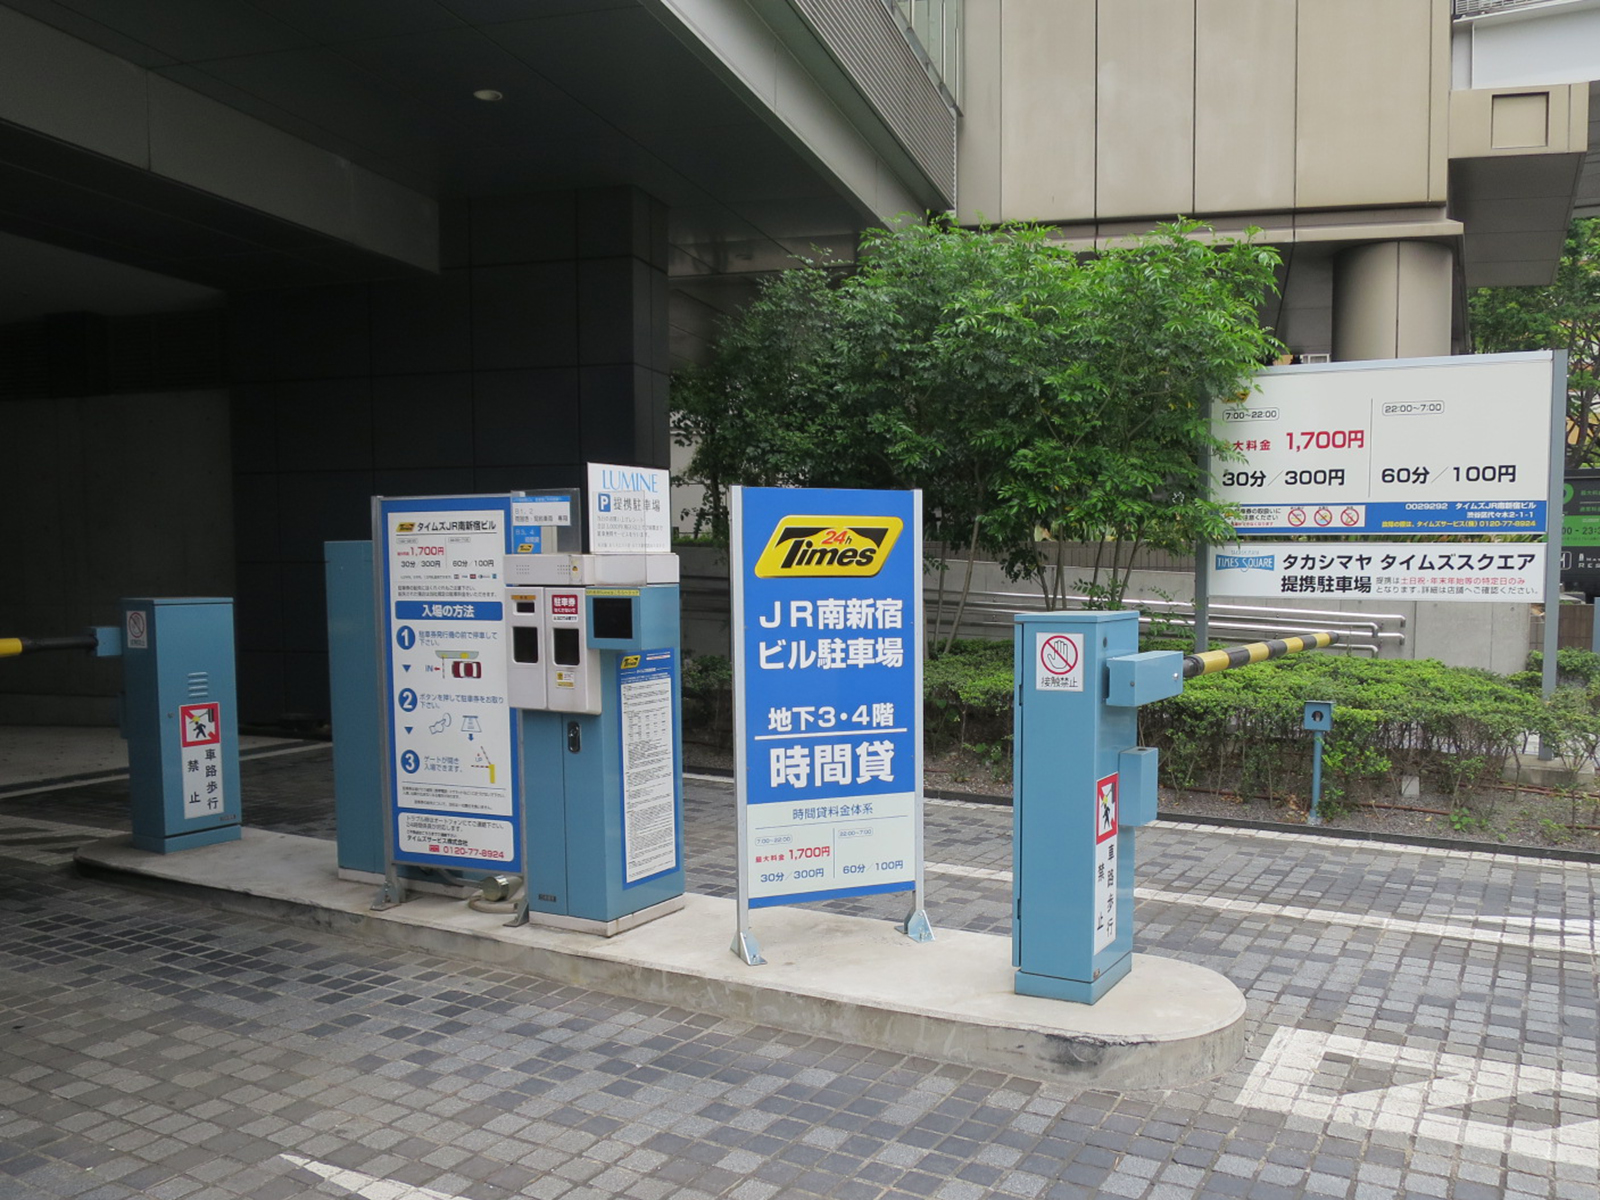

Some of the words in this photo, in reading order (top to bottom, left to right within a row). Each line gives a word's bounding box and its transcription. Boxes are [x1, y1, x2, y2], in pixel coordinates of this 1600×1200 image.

[1223, 439, 1271, 451] 大料金
[1286, 430, 1364, 452] 1,700円
[602, 470, 658, 493] LUMINE
[614, 497, 660, 512] 提携駐車場
[1405, 502, 1448, 510] 0029292
[417, 521, 496, 532] タイムズJR南新宿ビル
[410, 546, 444, 557] 1,700円
[780, 539, 877, 569] Times
[1216, 557, 1239, 568] TIMES
[1241, 556, 1273, 573] SQUARE
[1283, 553, 1372, 571] タカシマヤ
[1380, 553, 1536, 571] タイムズスクエア
[1281, 575, 1373, 593] 提携駐車場
[422, 604, 475, 618] 入場の方法
[759, 637, 904, 670] ビル駐車場
[425, 665, 434, 673] IN
[768, 703, 894, 732] 地下3・4階
[770, 740, 895, 788] 時間貸
[187, 759, 201, 804] 禁止
[204, 748, 219, 811] 車路歩行
[792, 803, 873, 820] 時間貸料金体系
[442, 845, 504, 859] 0120-77-8924
[788, 846, 830, 861] 1,700円
